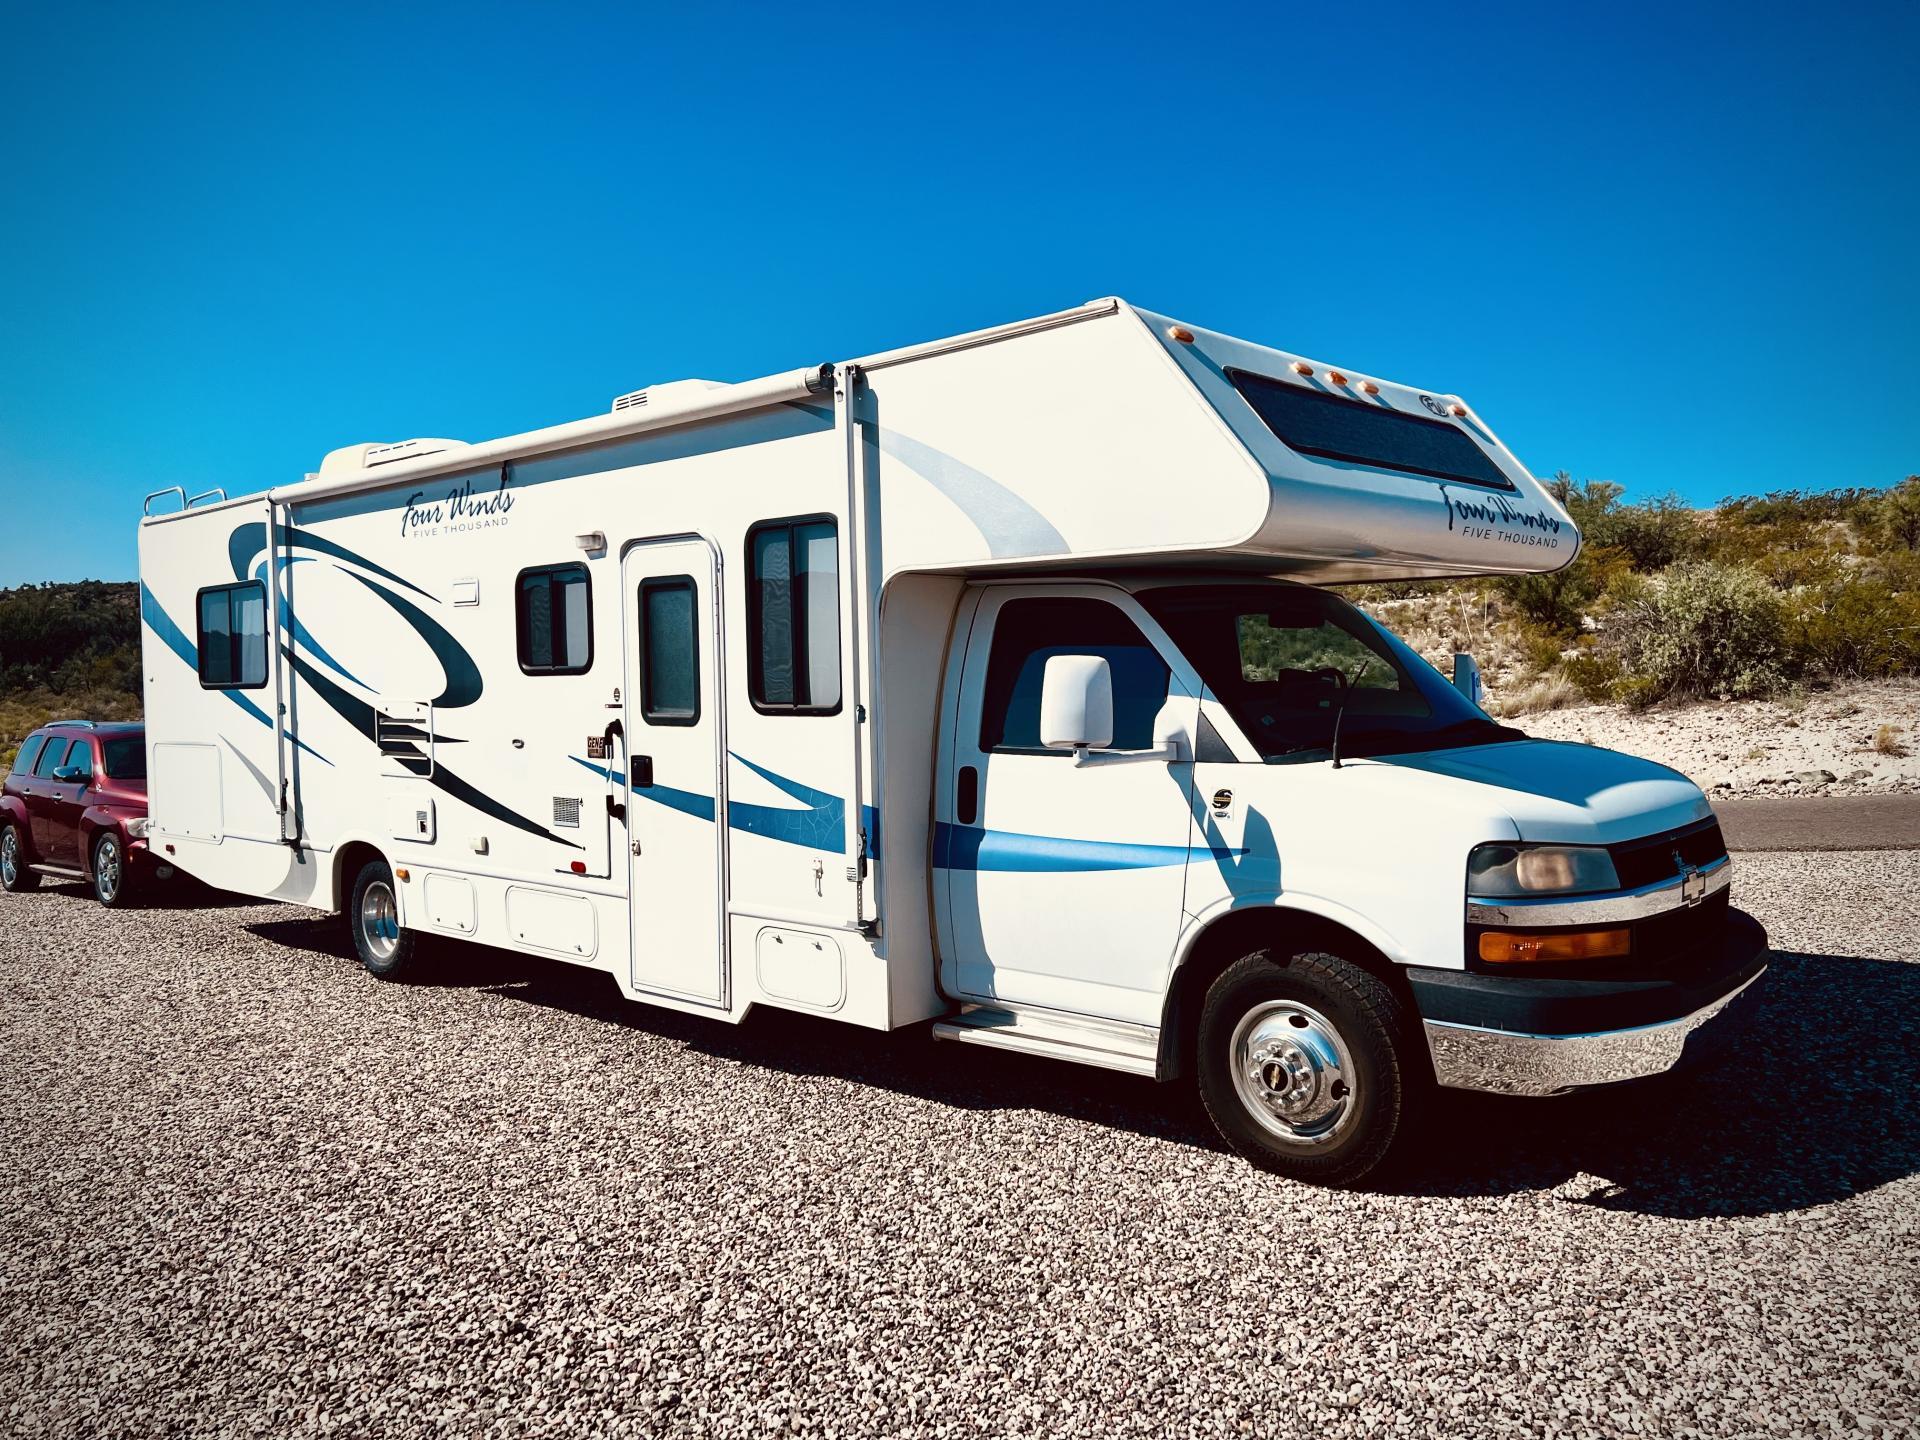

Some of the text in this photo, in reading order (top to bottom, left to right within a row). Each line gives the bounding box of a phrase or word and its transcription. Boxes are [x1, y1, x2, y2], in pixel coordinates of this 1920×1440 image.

[402, 479, 515, 538] Four Winds
[1438, 484, 1560, 534] Four Winds
[413, 516, 509, 538] FIVE THOUSAND
[1462, 526, 1559, 549] FIVE THOUSAND
[588, 737, 604, 749] GENE
